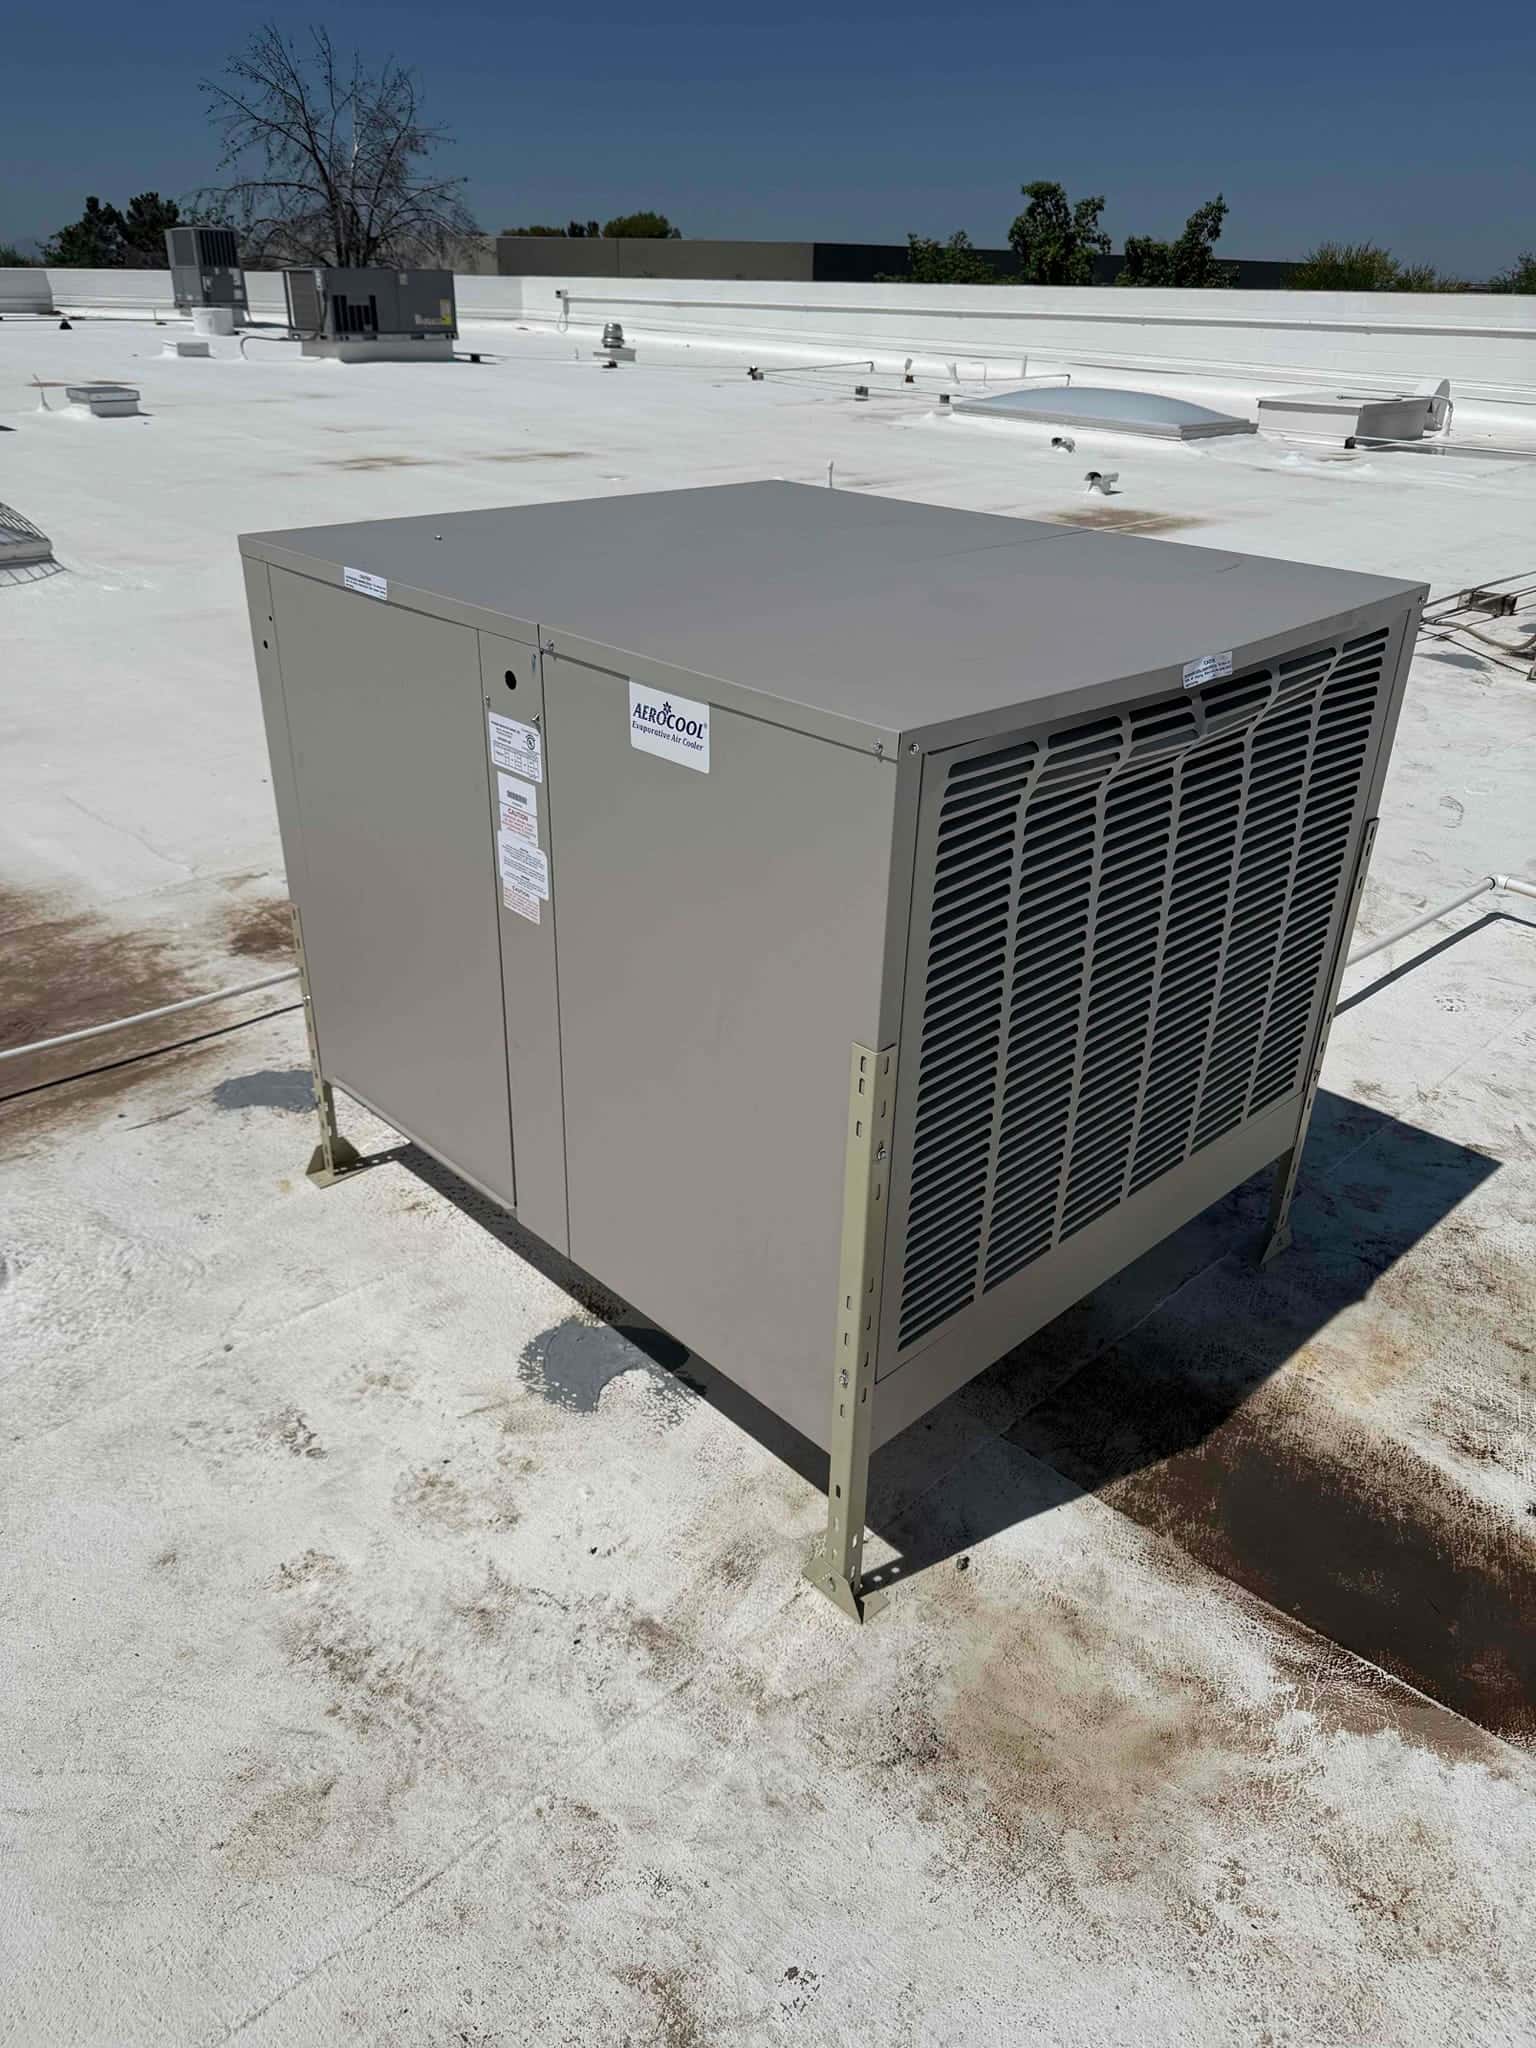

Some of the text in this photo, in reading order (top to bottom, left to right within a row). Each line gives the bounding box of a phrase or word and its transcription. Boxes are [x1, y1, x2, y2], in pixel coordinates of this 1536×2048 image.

[632, 720, 704, 752] Evaporative Air Cooler
